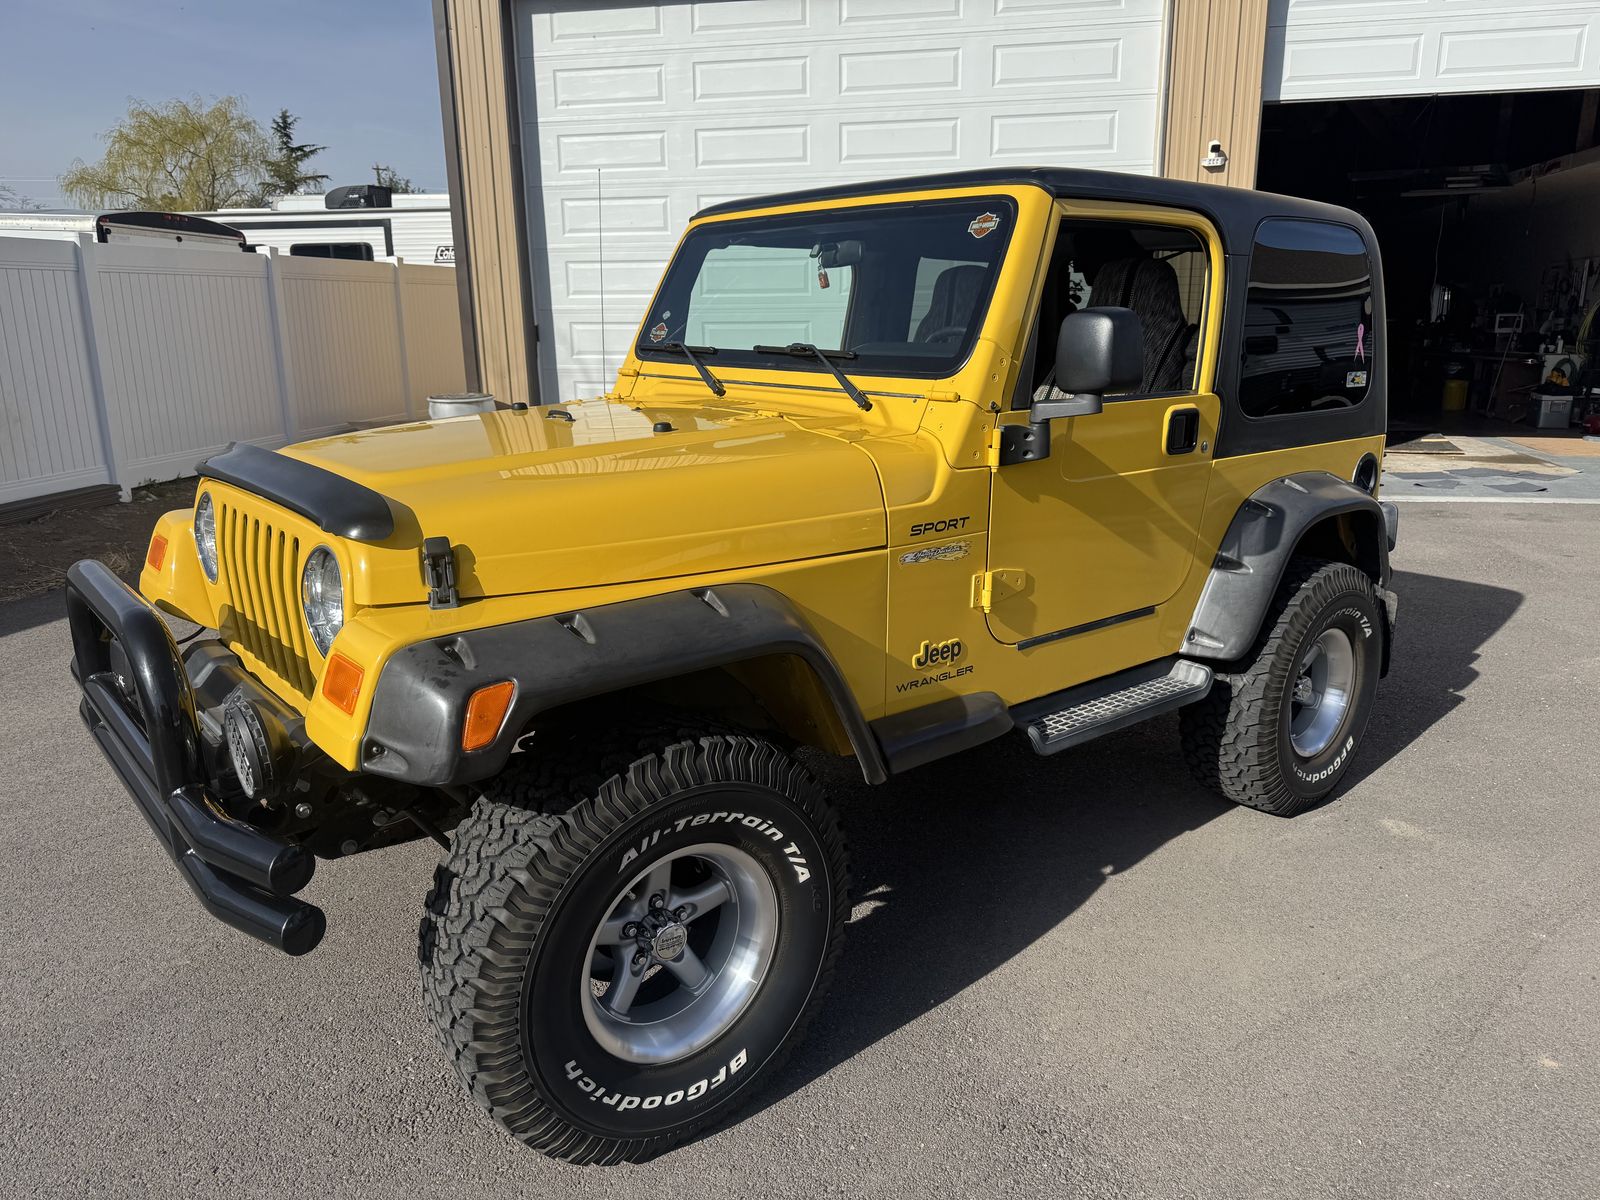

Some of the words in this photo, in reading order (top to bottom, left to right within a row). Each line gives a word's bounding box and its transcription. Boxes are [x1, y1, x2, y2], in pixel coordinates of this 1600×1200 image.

[909, 516, 970, 537] SPORT
[1360, 616, 1373, 639] T/A
[915, 639, 962, 667] Jeep
[896, 665, 974, 693] WRANGLER
[1292, 735, 1354, 783] BFGoodrich
[617, 811, 784, 874] All-Terrain
[783, 841, 811, 884] T/A
[564, 1048, 748, 1112] BFGoodrich
